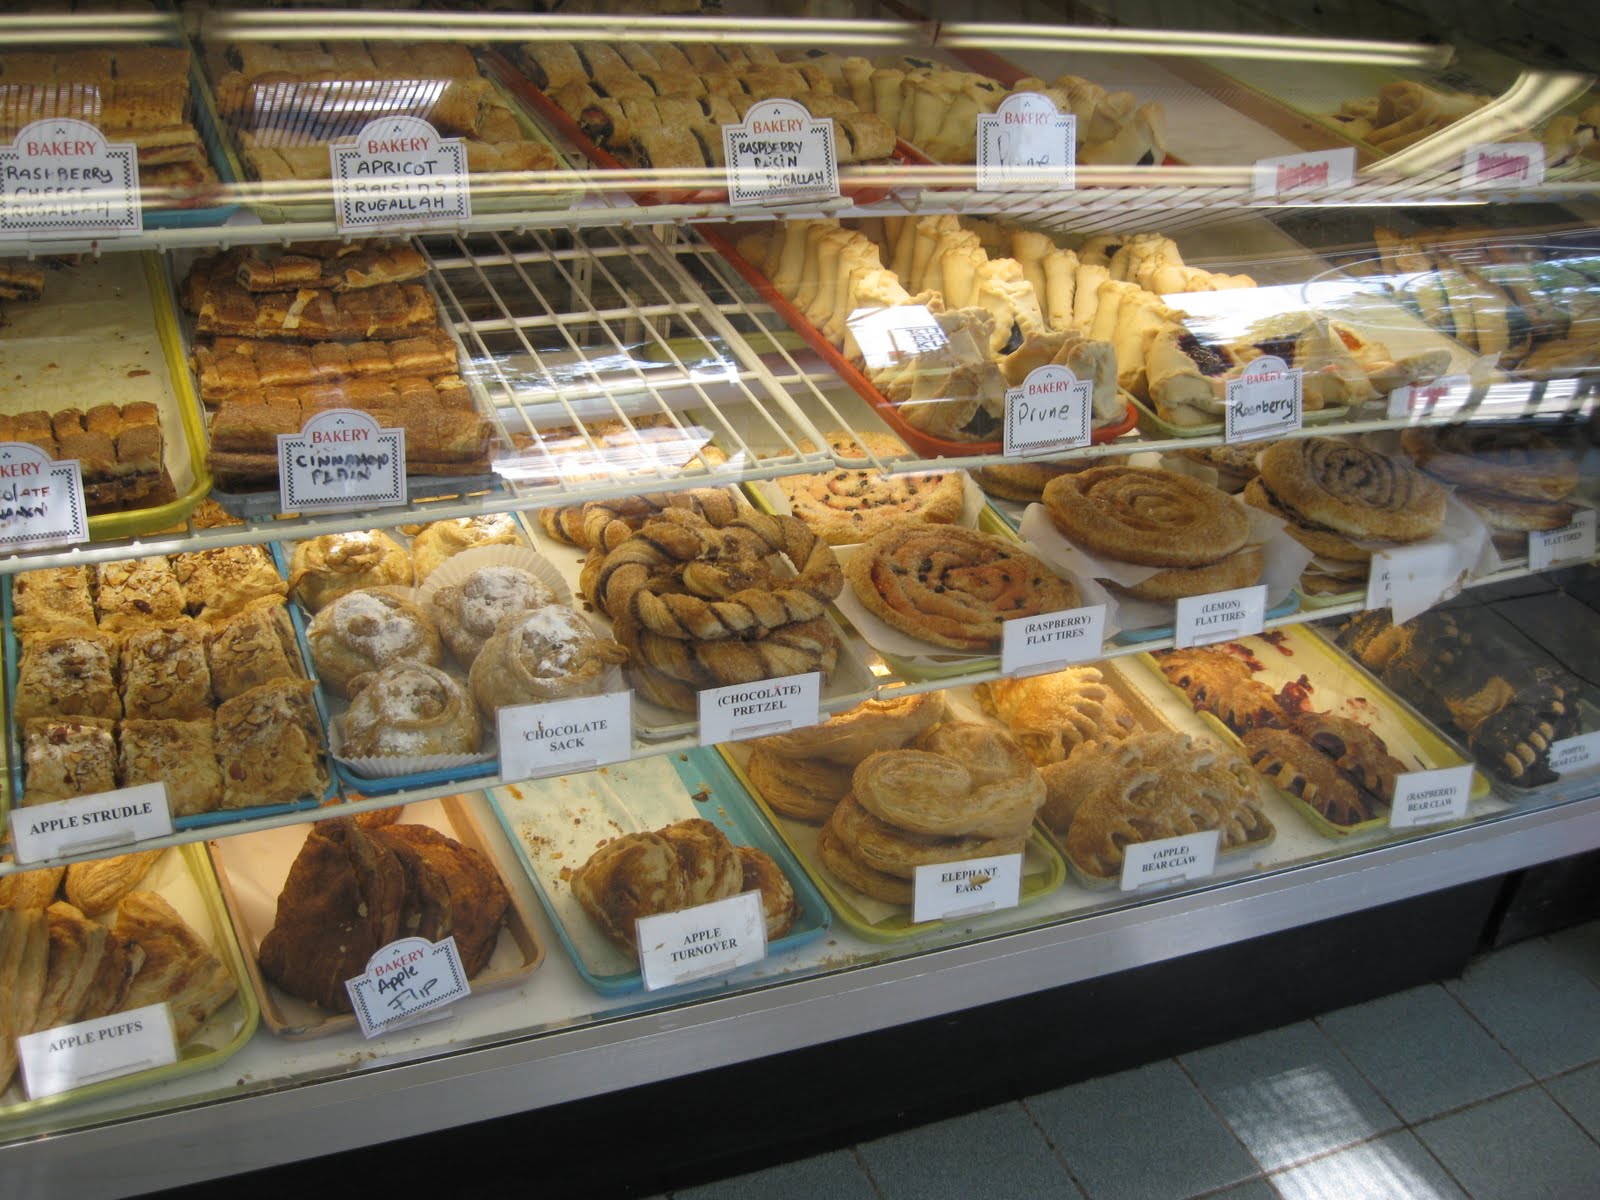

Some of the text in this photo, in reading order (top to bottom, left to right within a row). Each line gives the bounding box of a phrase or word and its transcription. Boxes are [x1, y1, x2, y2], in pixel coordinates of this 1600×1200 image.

[753, 118, 804, 134] BAKERY
[1004, 112, 1051, 125] BAKERY
[27, 141, 97, 156] BAKERY
[367, 137, 431, 154] BAKERY
[738, 140, 803, 155] RASPBERRY
[356, 160, 438, 176] APRICOT
[355, 196, 444, 213] RUGALLAH
[1246, 370, 1282, 384] BAKERY
[1029, 380, 1070, 395] BAKERY
[1018, 402, 1069, 426] Prune
[312, 428, 371, 443] BAKERY
[0, 462, 42, 478] KERY
[1202, 600, 1241, 614] (LEMON)
[1025, 615, 1092, 634] (RASPBERRY)
[1195, 610, 1246, 626] FLAT TIRES
[1027, 628, 1085, 645] FLAT TIRES
[718, 685, 801, 708] (CHOCOLATE)
[733, 700, 787, 717] PRETZEL
[549, 737, 585, 752] SACK
[1407, 787, 1457, 801] (RASPBERRY)
[1407, 798, 1452, 812] BEAR CLAW
[30, 802, 153, 835] APPLE STRUDLE
[1153, 846, 1190, 860] (APPLE)
[1142, 855, 1198, 872] BEAR CLAW
[683, 927, 722, 945] APPLE
[670, 938, 738, 962] TURNOVER
[375, 948, 425, 976] BAKERY
[378, 965, 419, 995] Apple
[48, 1021, 143, 1053] APPLE PUFFS
